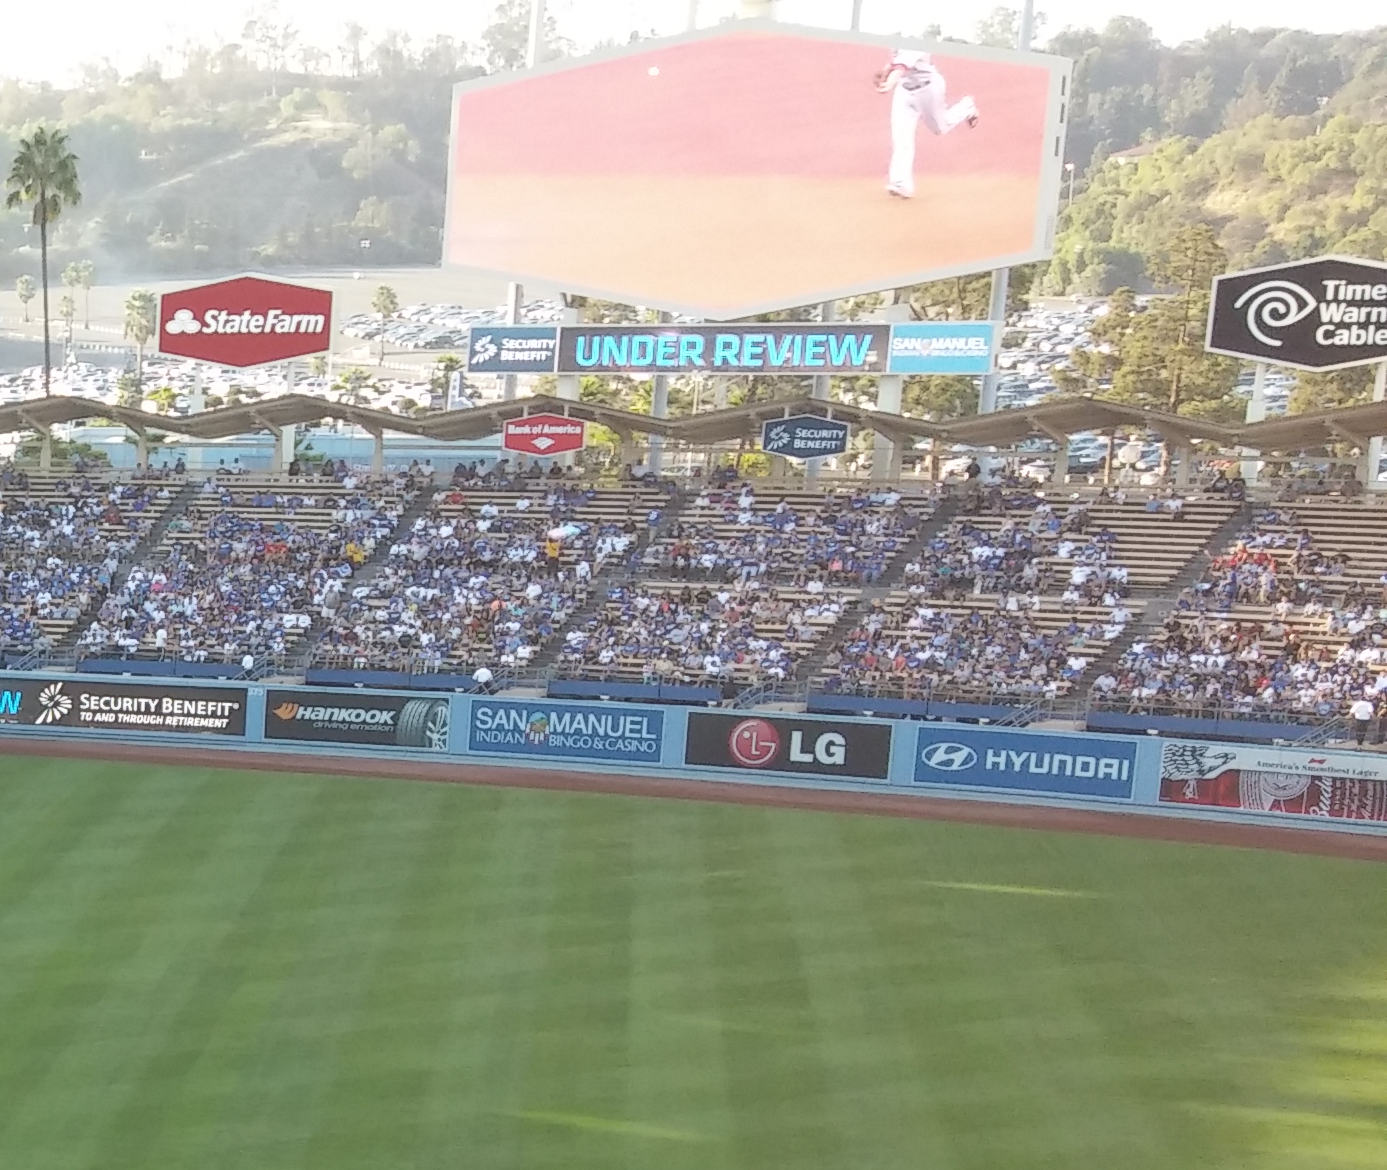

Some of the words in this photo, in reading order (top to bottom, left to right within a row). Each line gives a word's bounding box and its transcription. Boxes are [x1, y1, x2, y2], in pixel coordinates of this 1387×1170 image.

[1321, 280, 1387, 300] Time
[501, 338, 556, 350] SECURITY
[892, 337, 922, 350] SAN
[931, 337, 989, 350] MANUEL
[1315, 325, 1387, 345] Cable
[500, 350, 552, 361] BENEFIT
[576, 334, 706, 366] UNDER
[712, 334, 874, 366] REVIEW
[508, 424, 531, 435] Bank
[532, 424, 543, 435] of
[543, 424, 582, 435] America
[795, 428, 846, 440] SECURITY
[794, 439, 841, 450] BENEFIT
[80, 693, 159, 712] SECURITY
[80, 712, 93, 721] TO
[94, 713, 115, 722] AND
[117, 714, 163, 725] THROUGH
[165, 716, 229, 728] RETIREMENT
[313, 719, 344, 732] driving
[346, 722, 395, 733] emotion
[476, 707, 527, 731] SAN
[549, 711, 657, 739] MANUEL
[476, 730, 526, 745] INDIAN
[548, 734, 592, 749] BINGO
[605, 738, 657, 754] CASINO
[789, 730, 847, 765] LG
[986, 749, 1130, 781] HYUNDAI
[1256, 760, 1300, 771] America's
[1352, 767, 1380, 778] Lager
